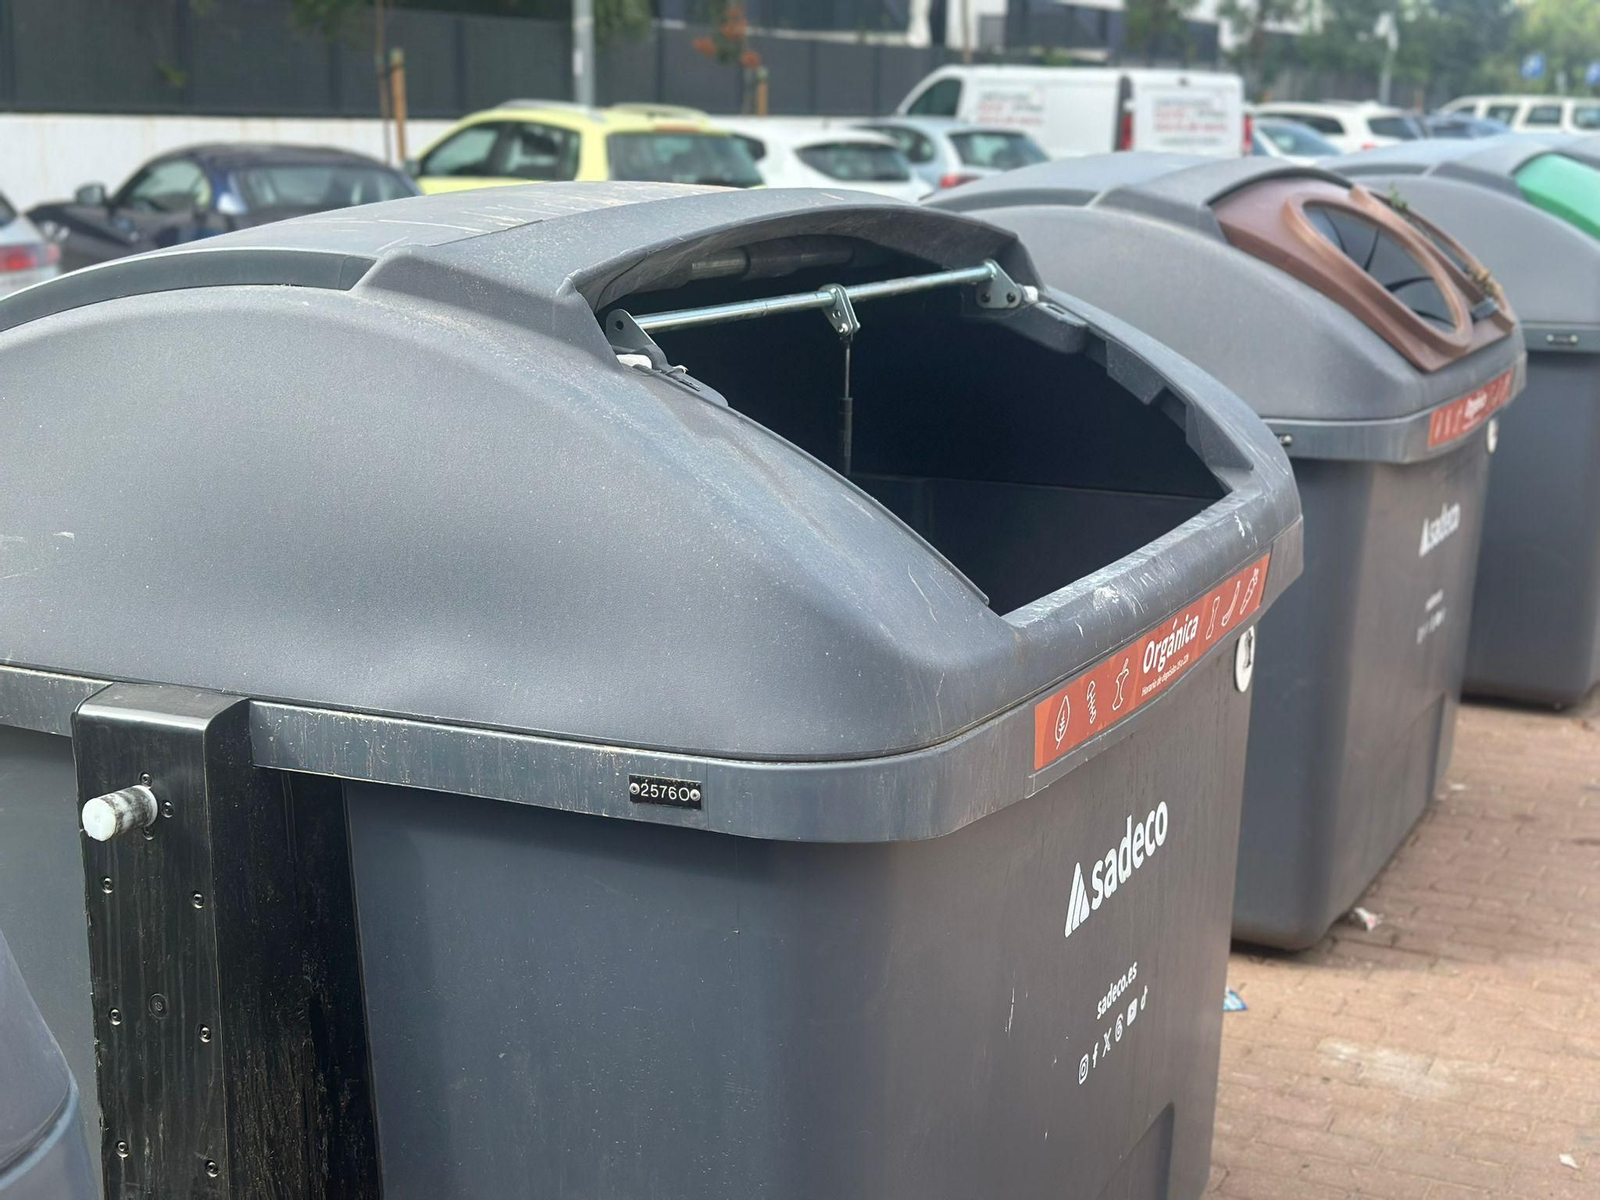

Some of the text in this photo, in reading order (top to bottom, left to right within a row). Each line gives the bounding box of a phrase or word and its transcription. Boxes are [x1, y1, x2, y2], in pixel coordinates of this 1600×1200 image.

[1142, 613, 1200, 675] Orgánica
[640, 783, 690, 801] 25760
[1091, 801, 1168, 911] sadeco
[1096, 961, 1138, 1020] sadeco.es
